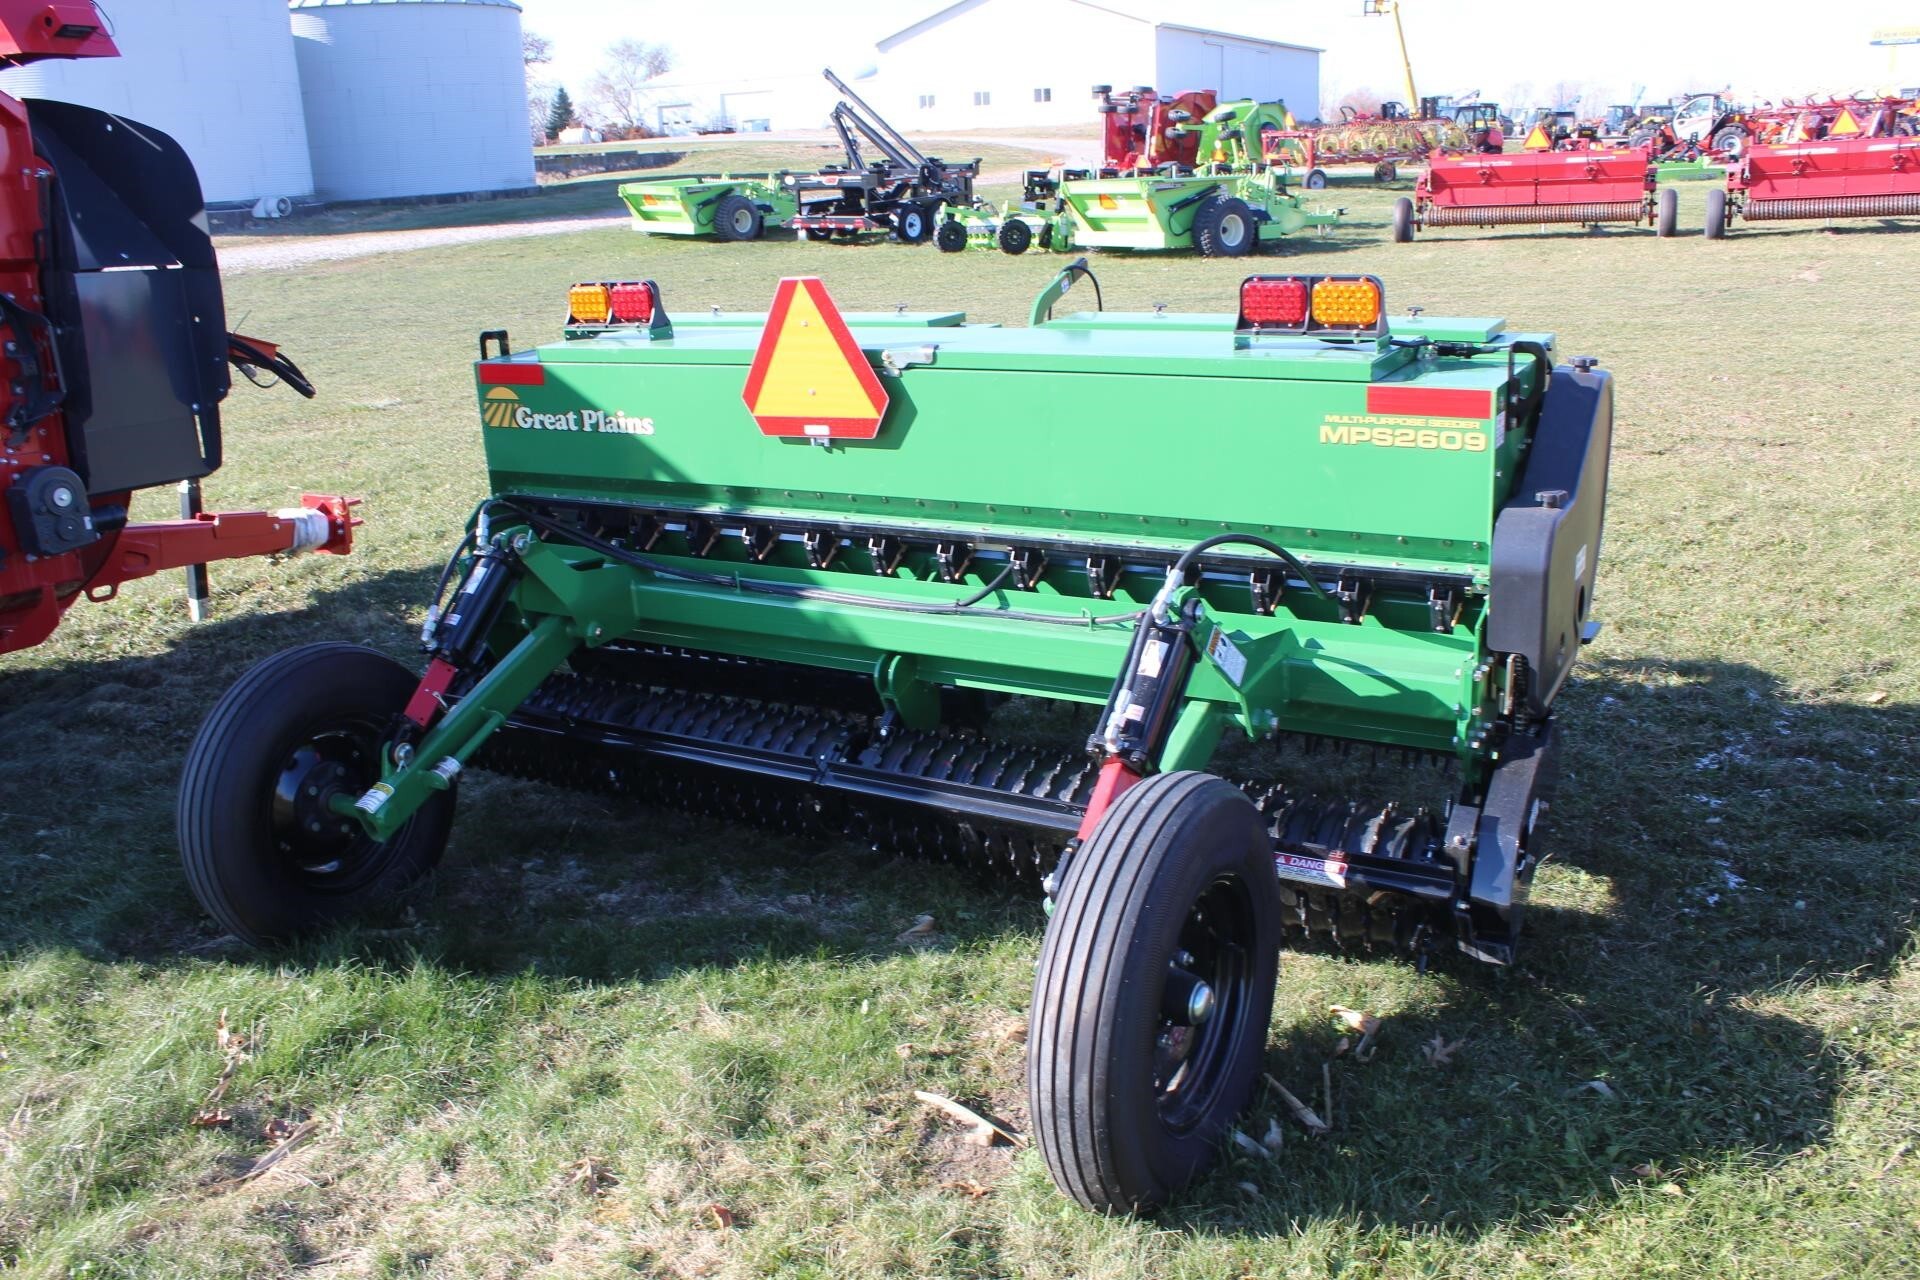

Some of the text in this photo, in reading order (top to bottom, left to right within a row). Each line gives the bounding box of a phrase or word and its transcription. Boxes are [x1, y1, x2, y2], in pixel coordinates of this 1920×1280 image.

[515, 406, 655, 435] Great Plains
[1325, 415, 1481, 429] MULTI-PURPOSE SEEDER
[1319, 425, 1487, 451] MPS2609
[1289, 858, 1340, 874] DANG
